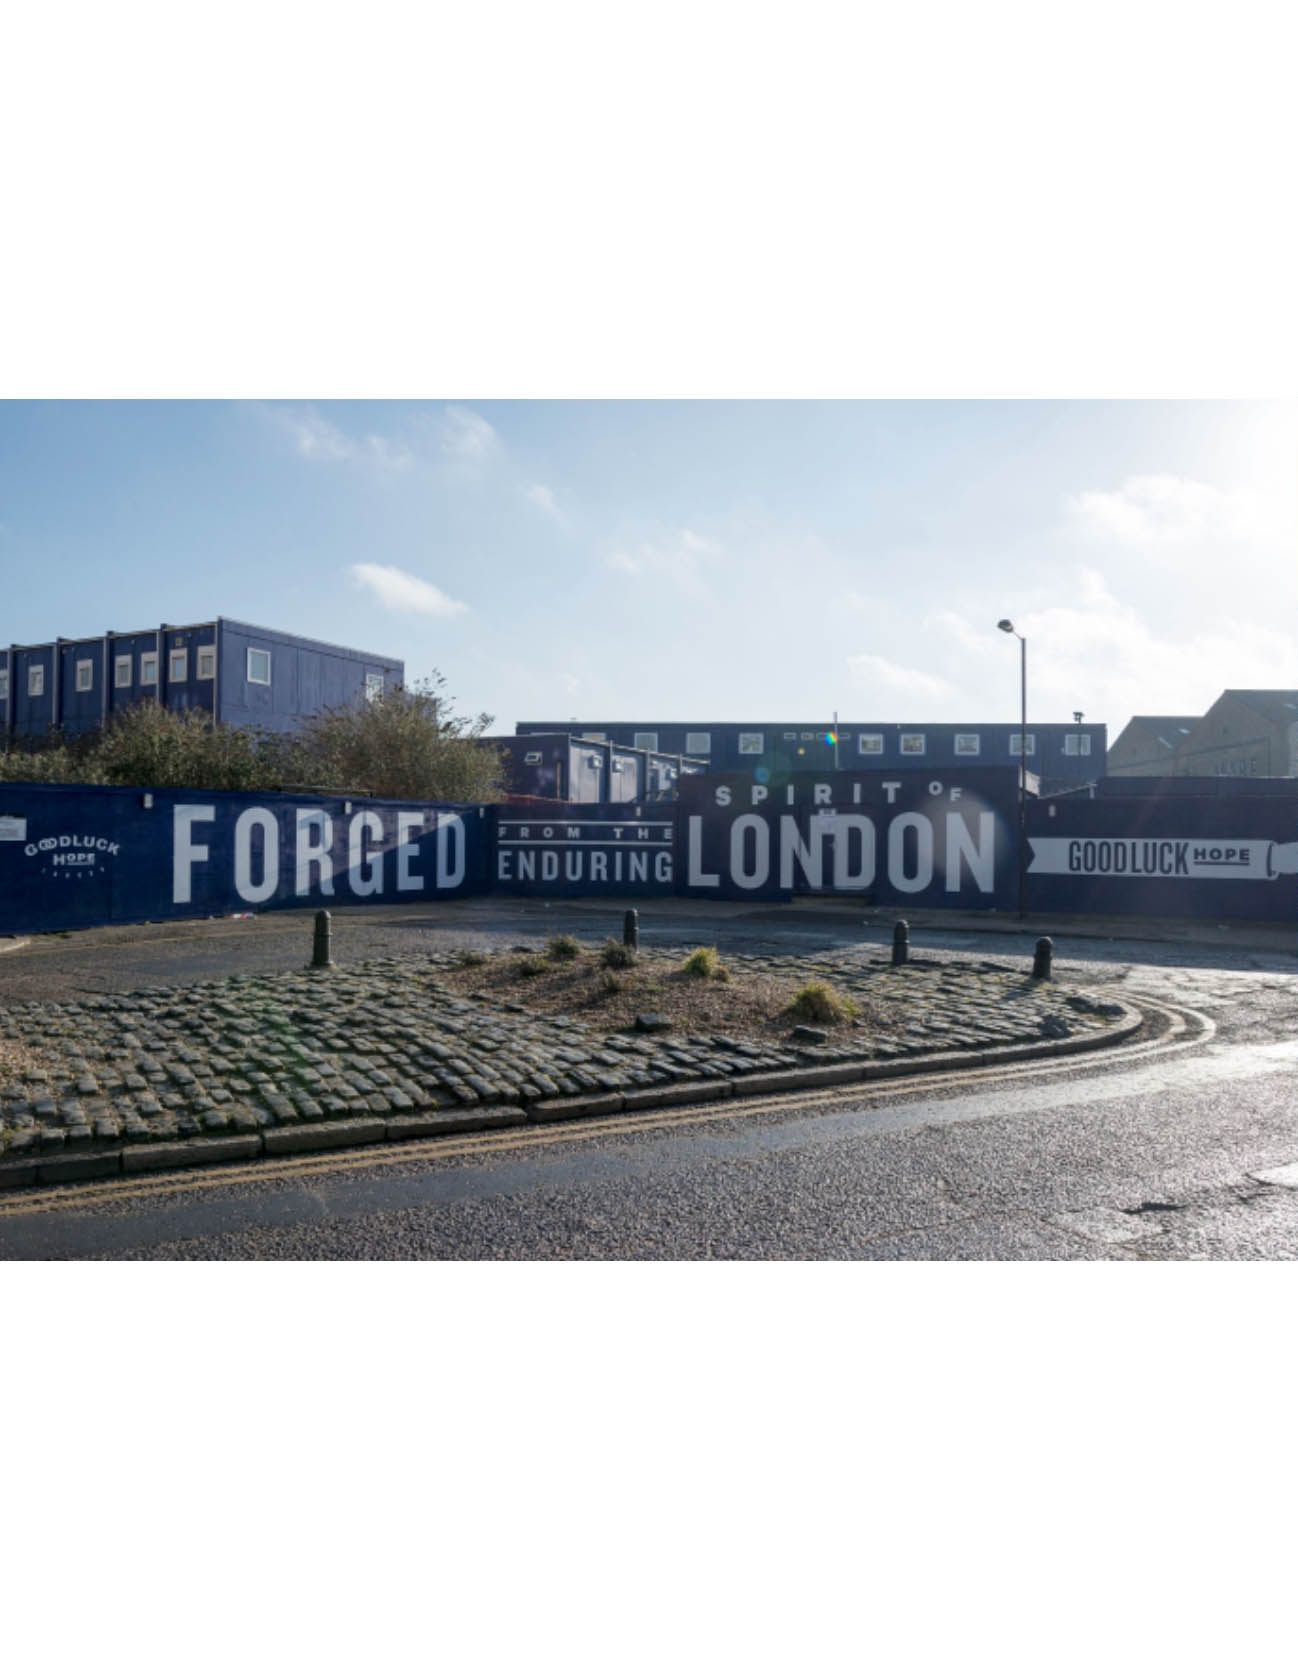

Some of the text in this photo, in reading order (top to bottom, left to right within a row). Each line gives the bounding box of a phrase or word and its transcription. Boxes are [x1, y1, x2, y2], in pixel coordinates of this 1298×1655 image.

[715, 780, 963, 806] SPIRIT OF
[24, 834, 120, 856] GOODLUCK
[499, 826, 673, 840] FROM THE
[173, 804, 467, 904] FORGED
[688, 811, 995, 893] LONDON
[1193, 848, 1250, 861] HOPE
[498, 851, 673, 882] ENDURING
